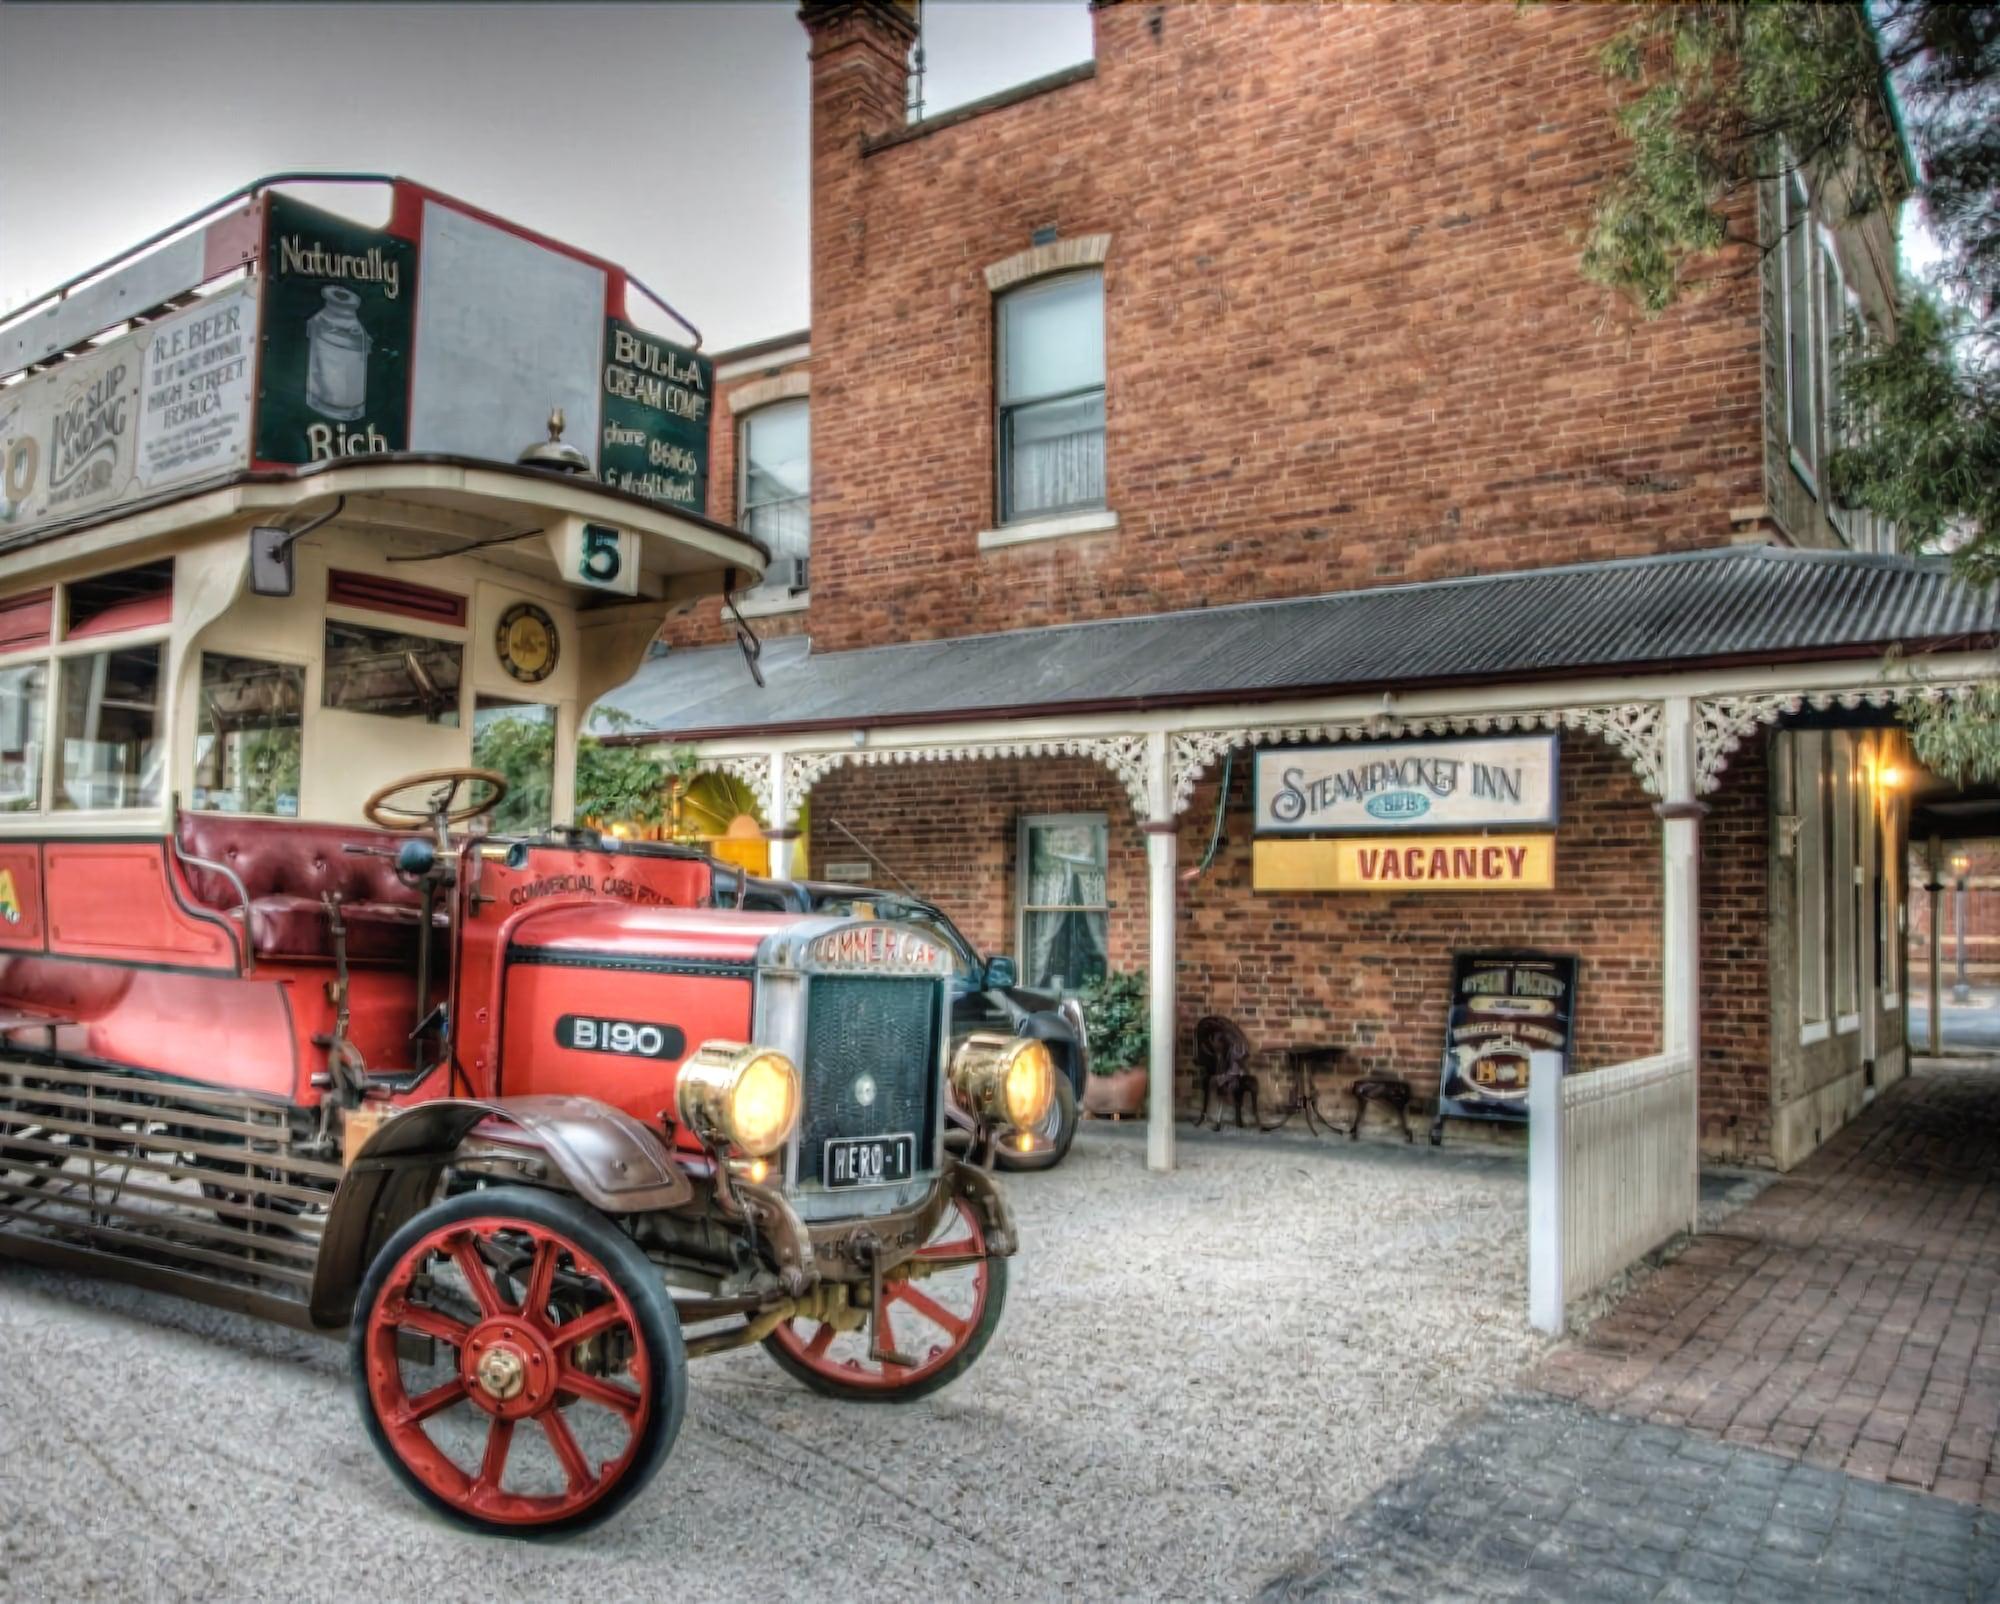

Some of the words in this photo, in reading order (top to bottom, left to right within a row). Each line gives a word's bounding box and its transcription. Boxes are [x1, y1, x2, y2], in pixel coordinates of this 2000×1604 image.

[279, 234, 400, 298] Naturally
[614, 330, 705, 392] BULLA
[308, 423, 388, 462] Rich
[579, 523, 622, 580] 5
[1473, 762, 1522, 802] INN
[1357, 846, 1527, 880] VACANCY
[573, 1019, 663, 1056] B190
